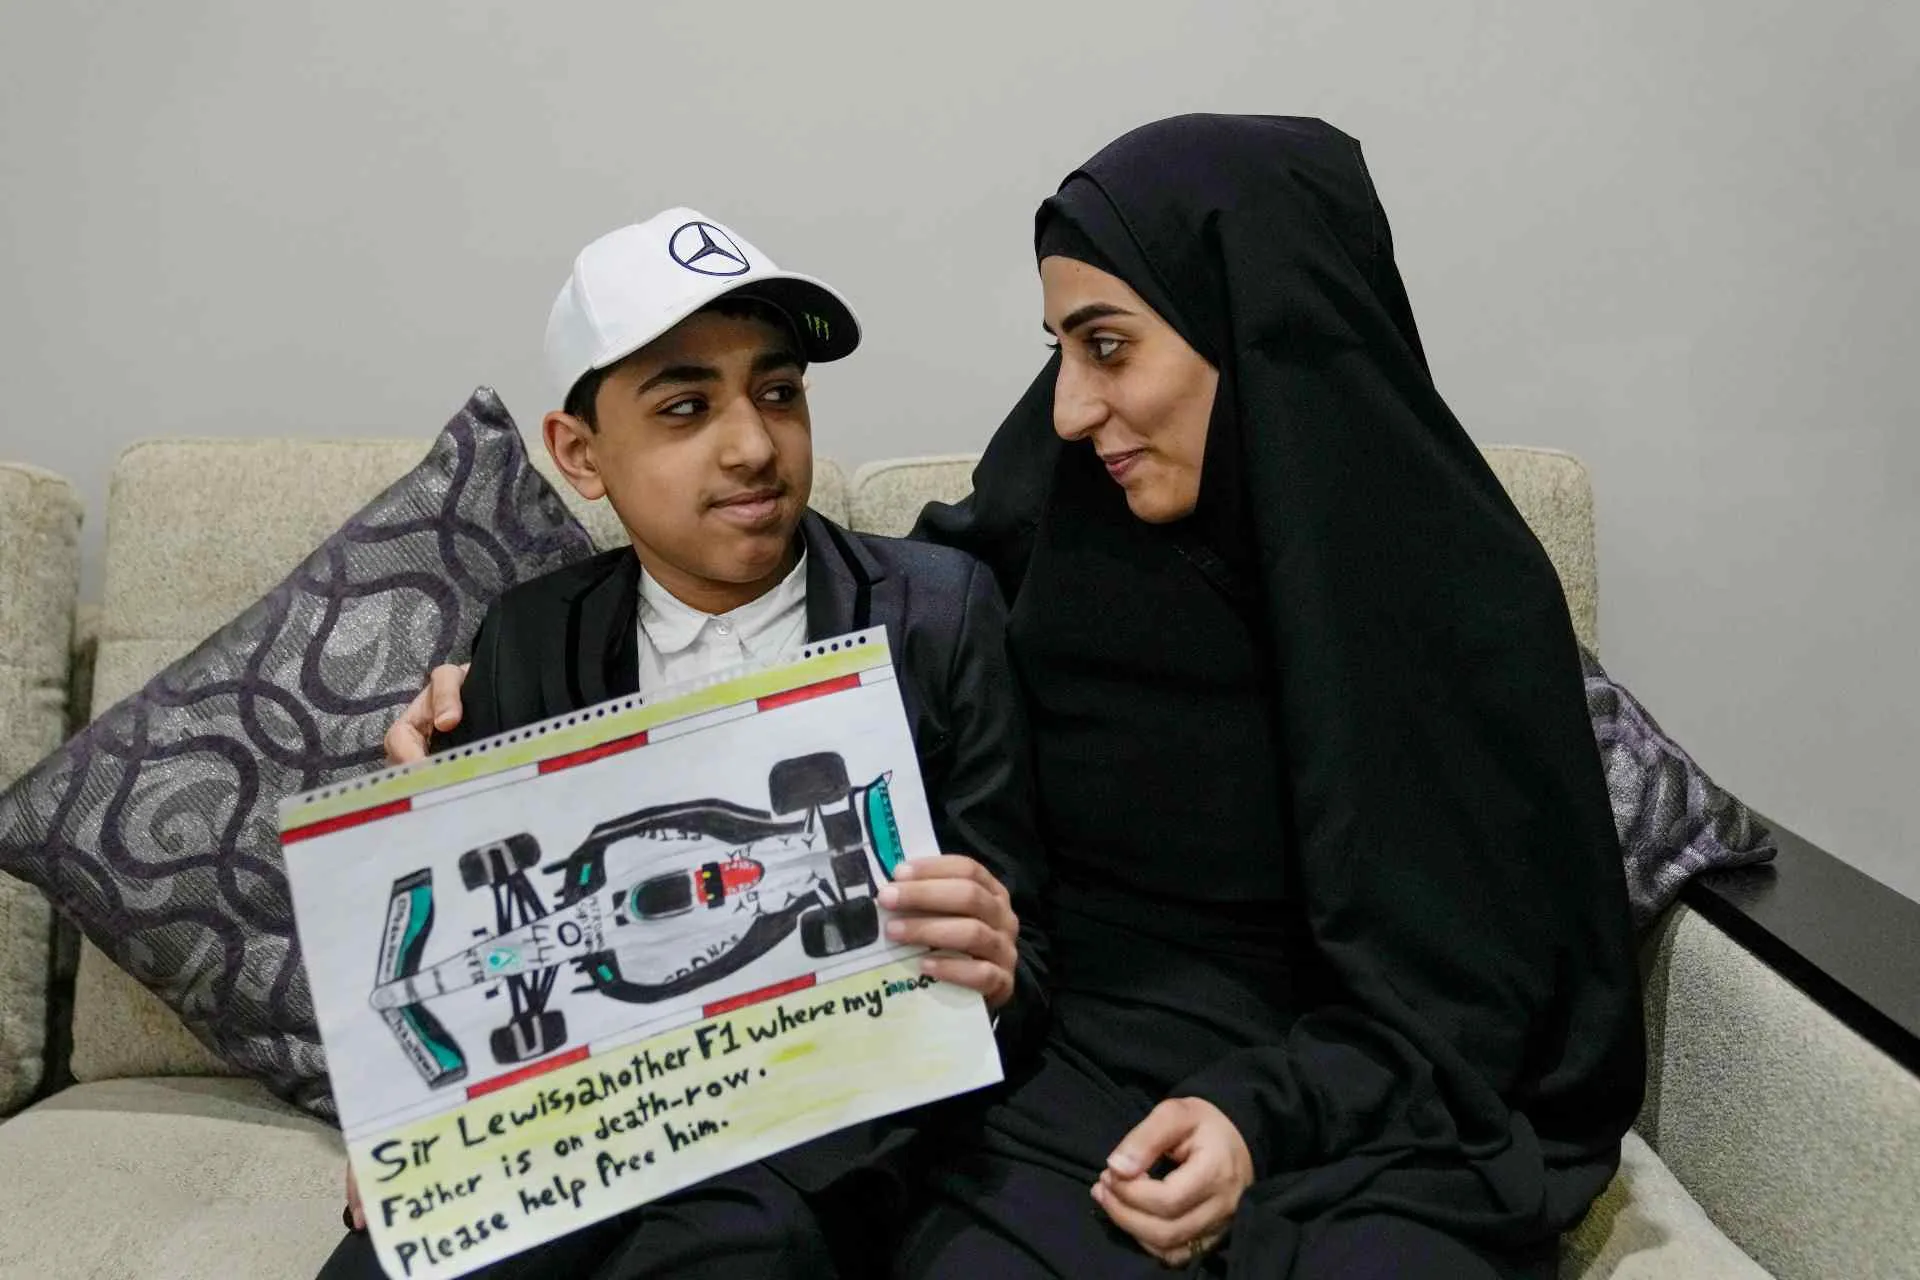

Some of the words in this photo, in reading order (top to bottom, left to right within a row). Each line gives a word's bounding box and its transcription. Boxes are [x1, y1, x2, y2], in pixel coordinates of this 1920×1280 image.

[371, 1134, 441, 1183] Sir
[576, 1046, 691, 1106] another
[694, 1020, 742, 1060] F1
[746, 1000, 836, 1043] where
[841, 989, 883, 1018] my
[381, 1174, 483, 1228] Father
[501, 1149, 532, 1178] is
[554, 1134, 584, 1158] on
[594, 1067, 767, 1140] death-row.
[393, 1212, 509, 1278] Please
[518, 1174, 587, 1216] help
[596, 1151, 656, 1188] free
[663, 1119, 730, 1153] him.
